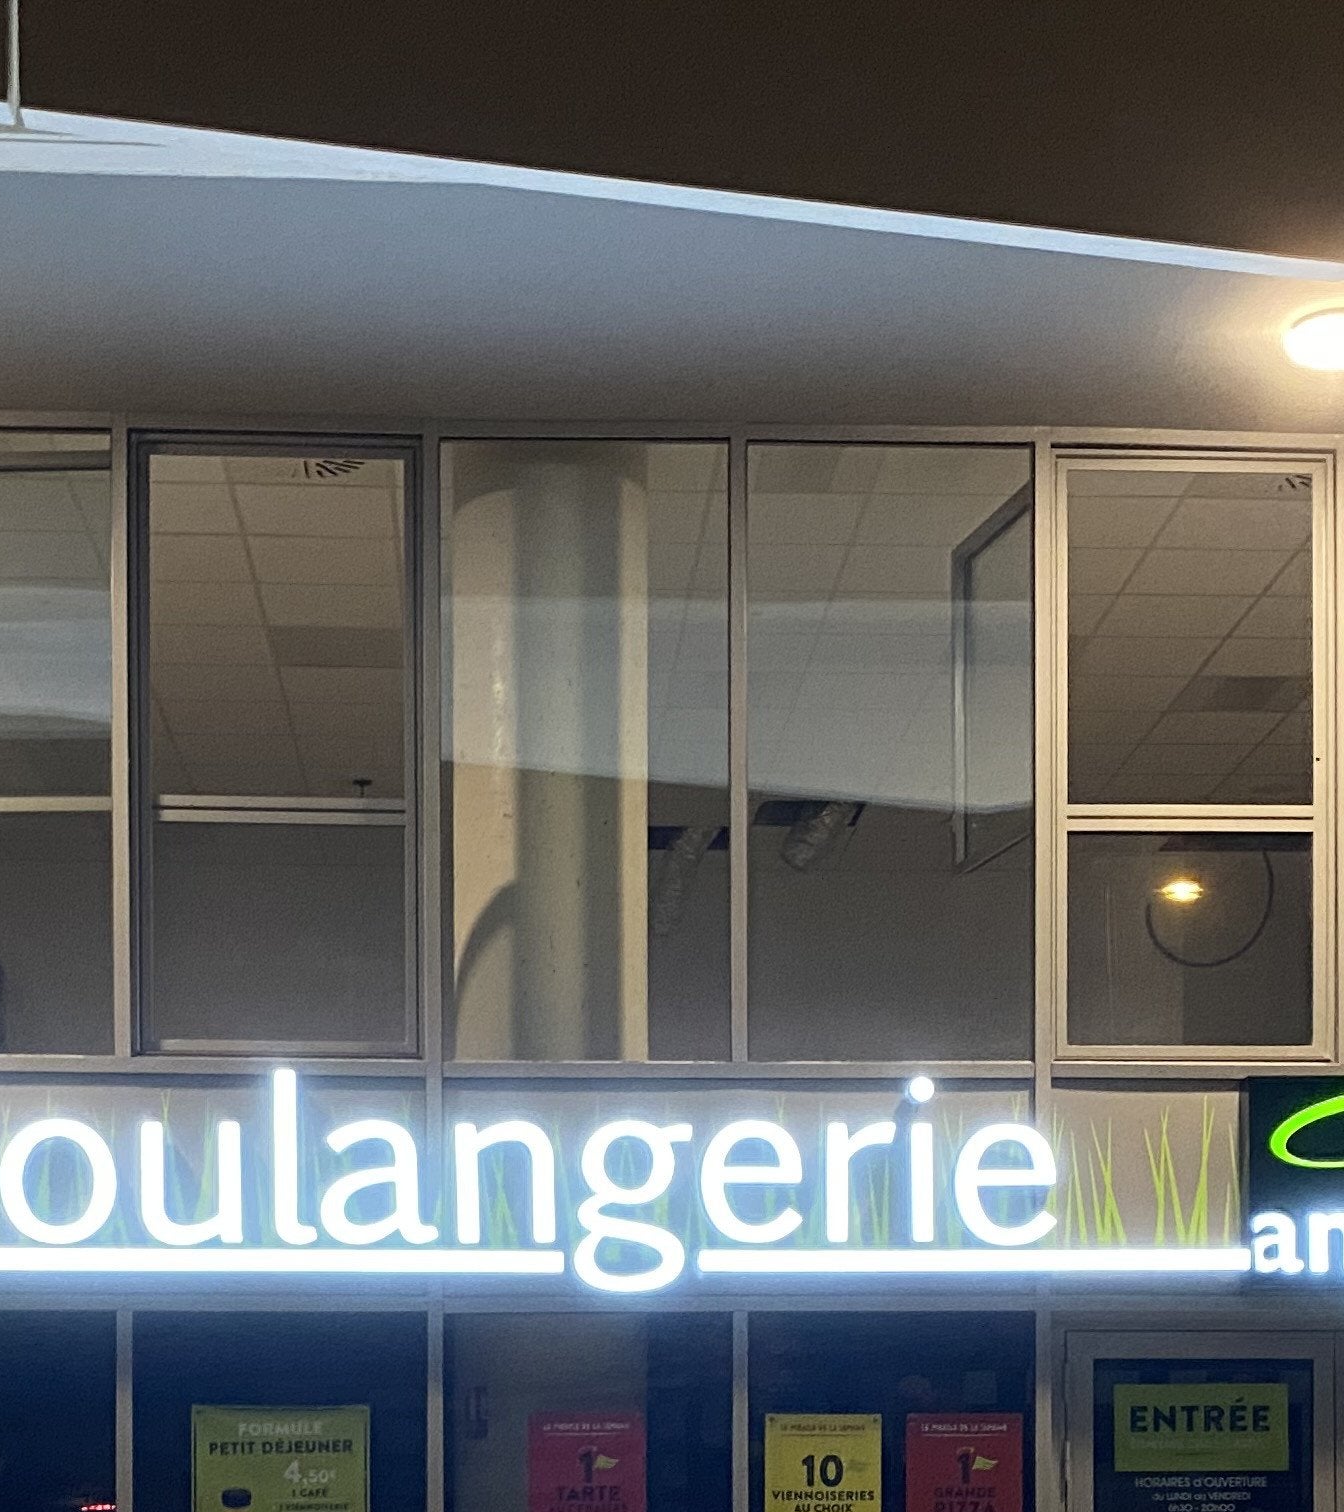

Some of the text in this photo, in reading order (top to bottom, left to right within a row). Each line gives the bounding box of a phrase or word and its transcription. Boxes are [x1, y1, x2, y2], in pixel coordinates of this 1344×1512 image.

[1130, 1397, 1270, 1433] ENTRÉE
[239, 1421, 322, 1436] FORMULE
[209, 1438, 353, 1455] PETIT DÉJEUNER
[578, 1447, 594, 1484] 1
[802, 1455, 843, 1487] 10
[957, 1449, 970, 1485] 1
[1136, 1477, 1190, 1487] HORAIRES
[557, 1485, 621, 1501] TARTE
[772, 1491, 874, 1501] VIENNOISERIES
[934, 1486, 996, 1498] GRANDE
[1207, 1492, 1251, 1500] VENDREDI
[794, 1503, 853, 1512] AU CHOIX
